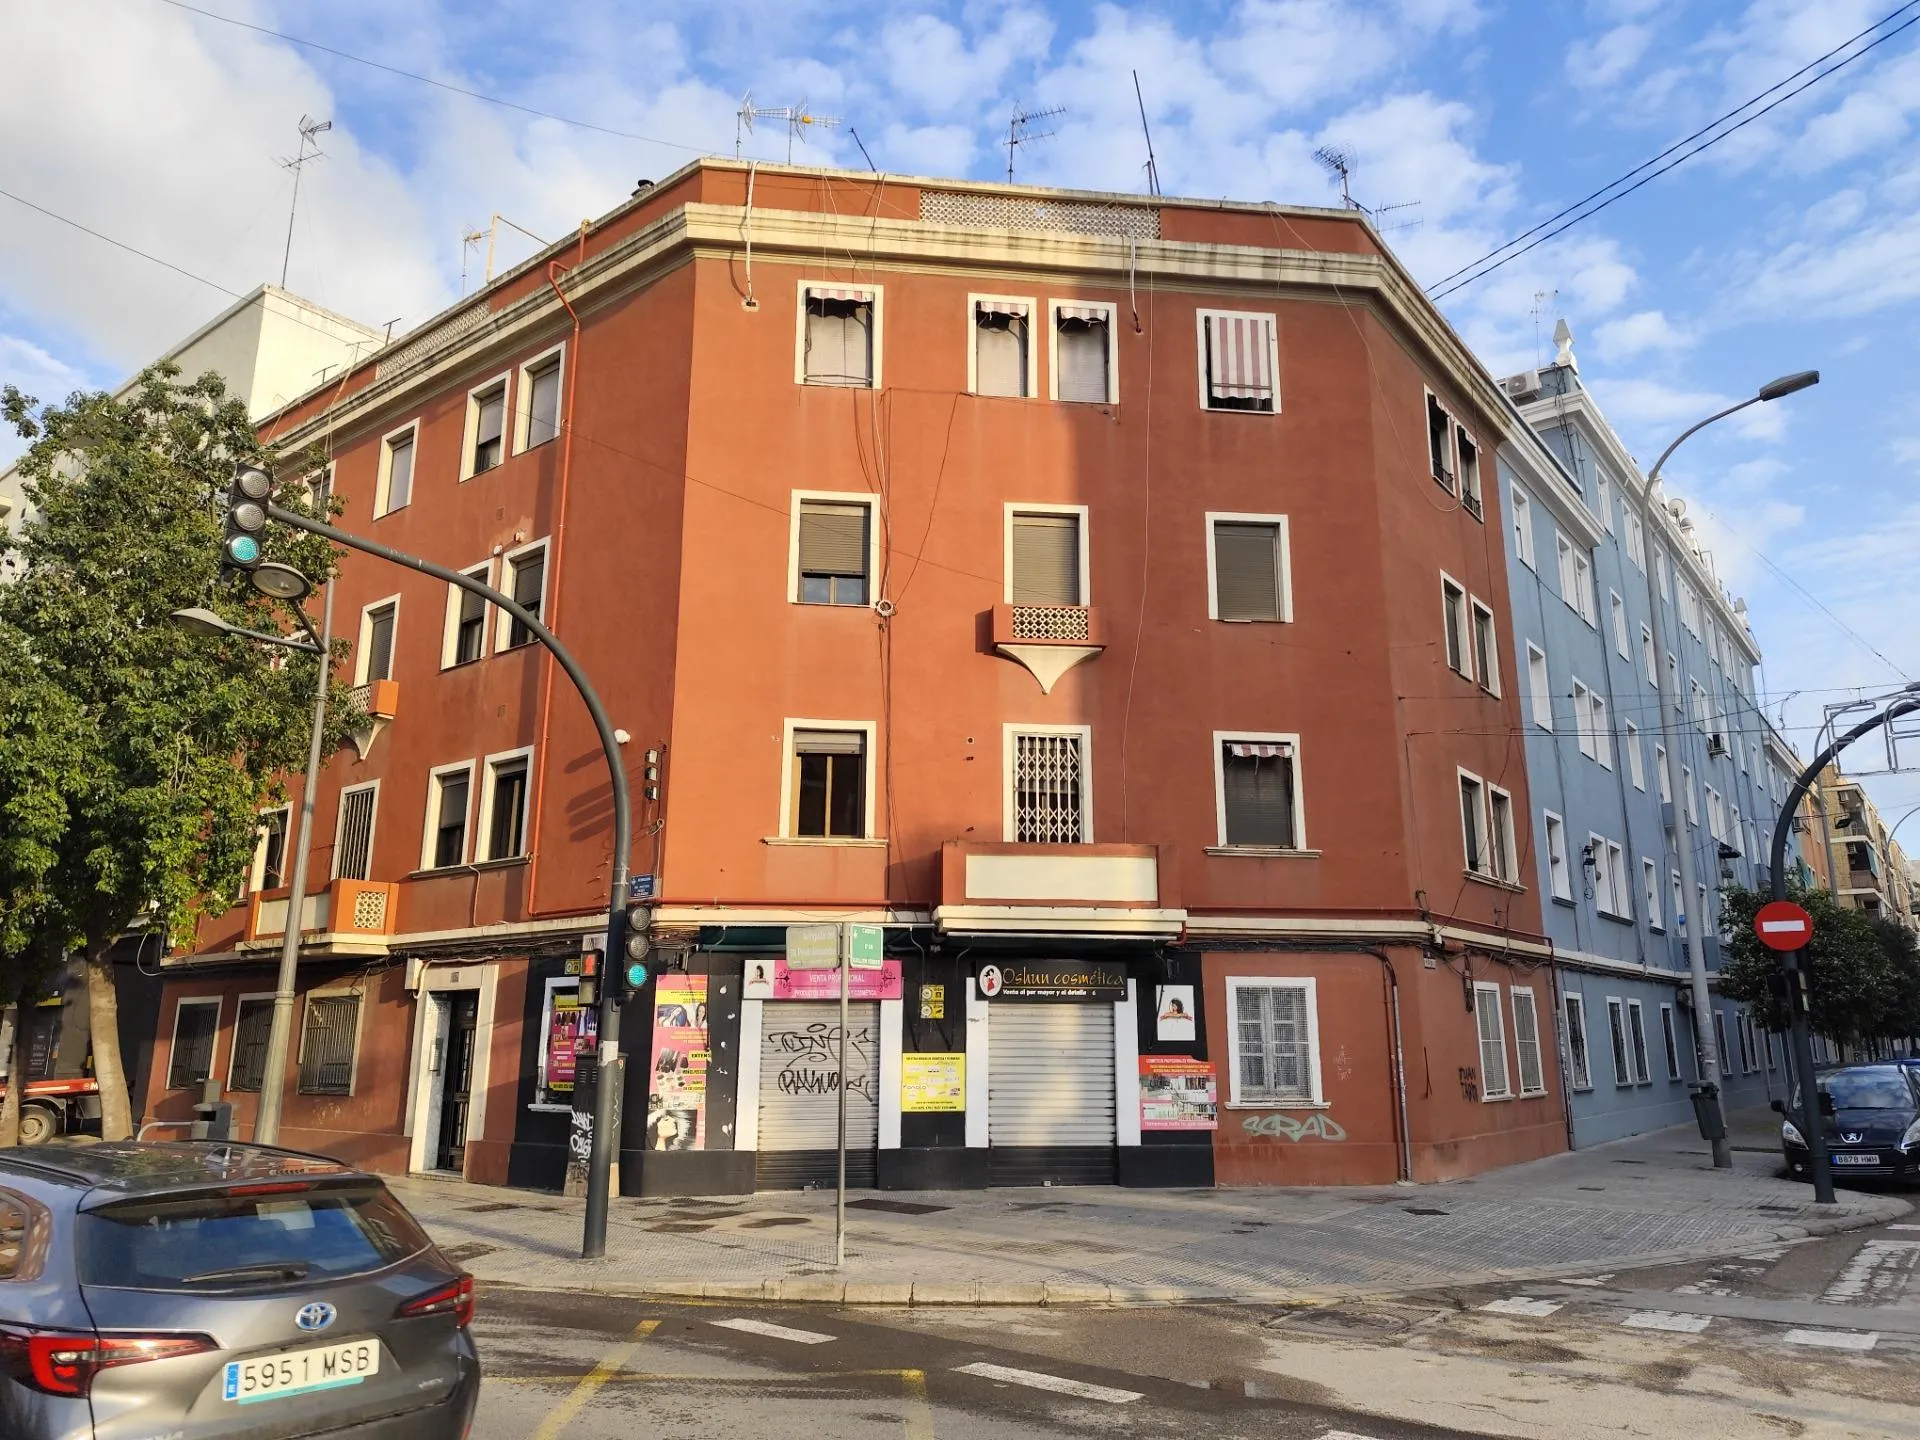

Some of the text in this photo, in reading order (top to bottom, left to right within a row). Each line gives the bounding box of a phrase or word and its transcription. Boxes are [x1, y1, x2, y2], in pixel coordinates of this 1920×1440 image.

[809, 974, 827, 983] VENTA
[1003, 966, 1124, 985] Oshun cosmética
[243, 1346, 370, 1391] 5951 MSB
